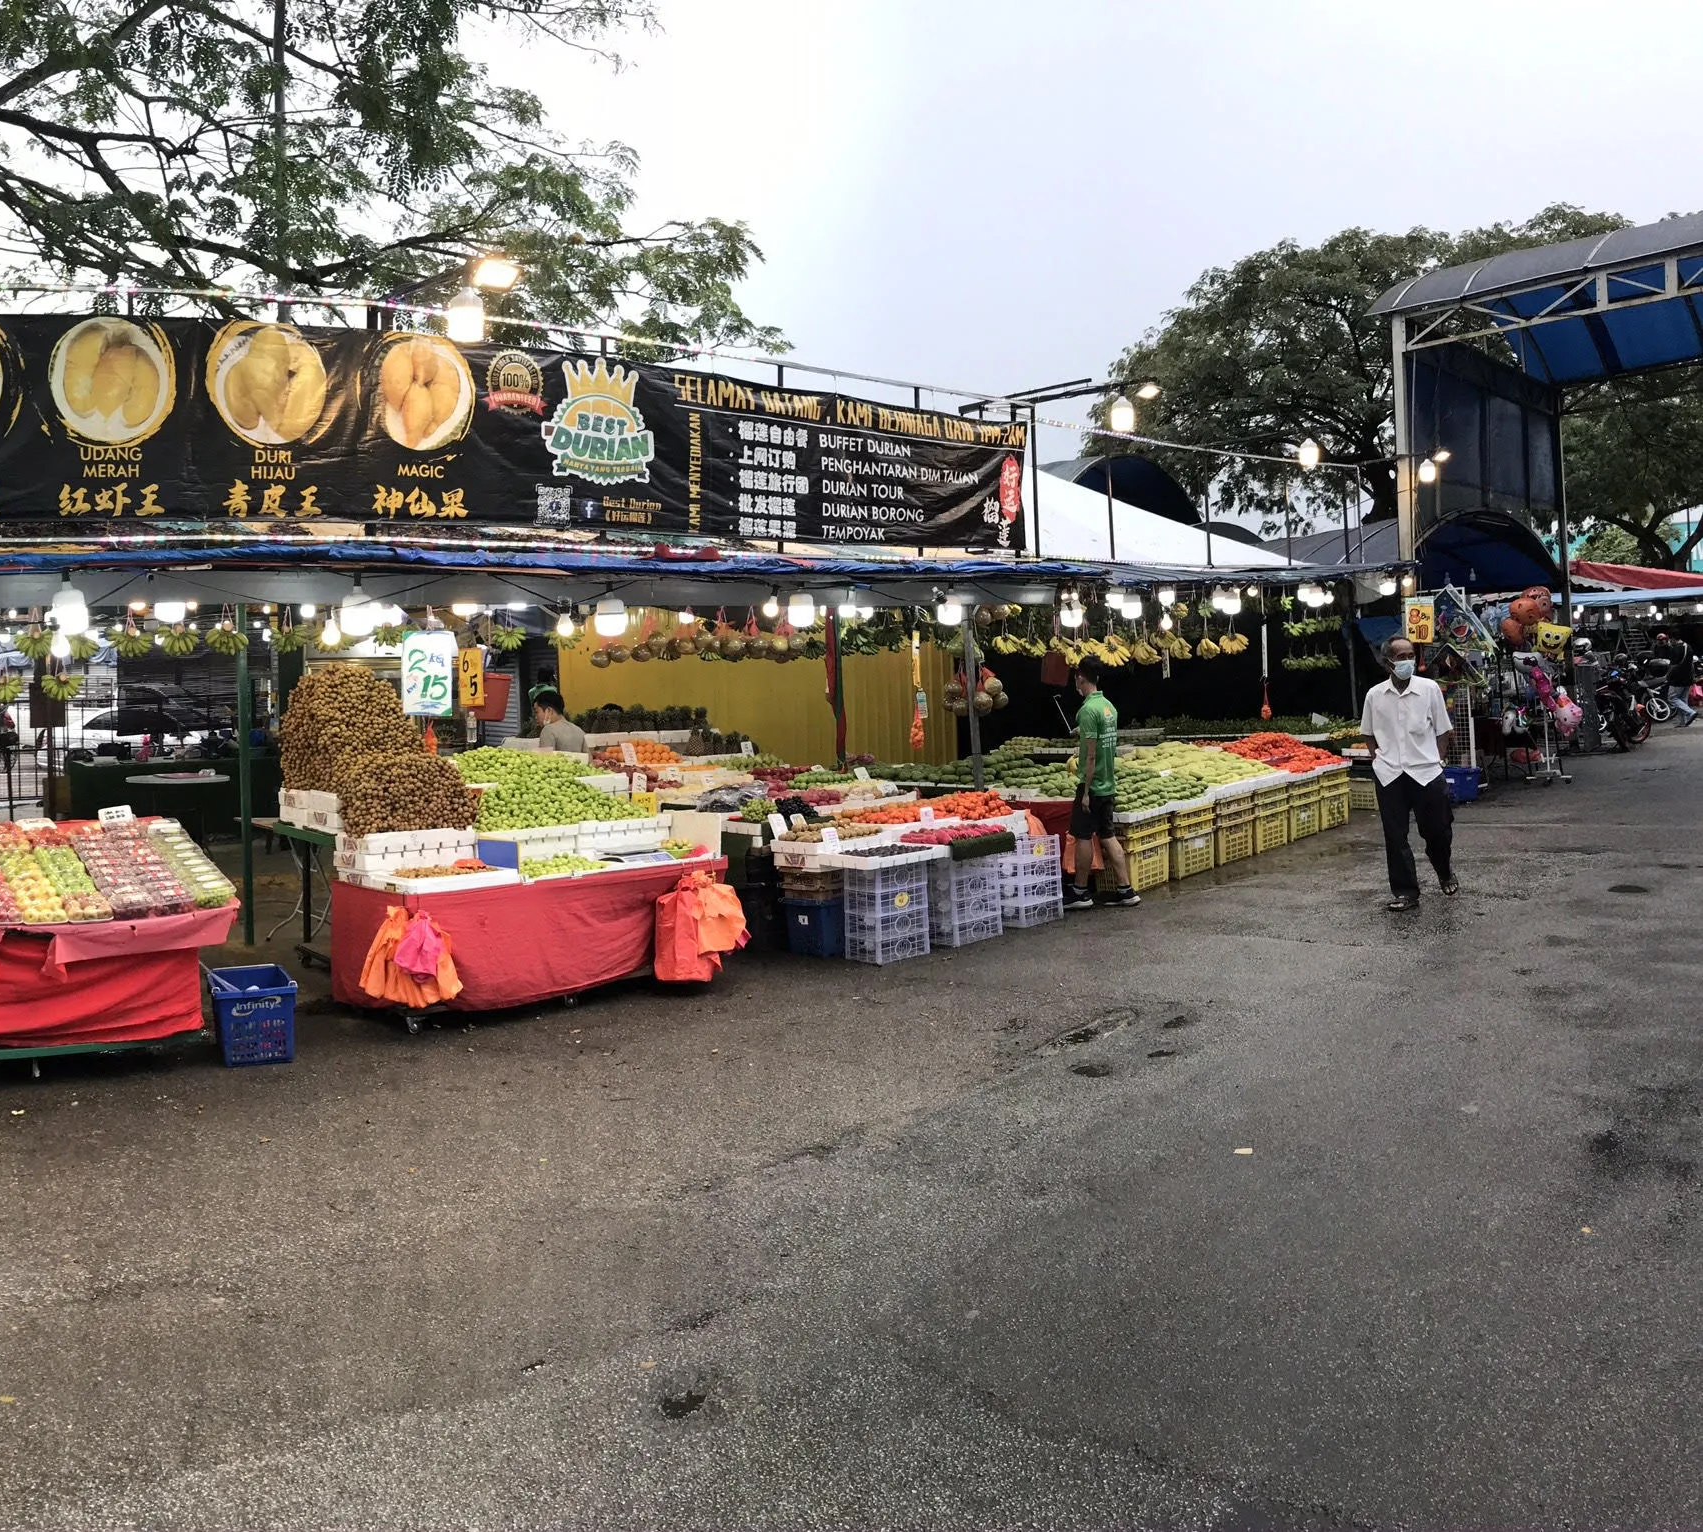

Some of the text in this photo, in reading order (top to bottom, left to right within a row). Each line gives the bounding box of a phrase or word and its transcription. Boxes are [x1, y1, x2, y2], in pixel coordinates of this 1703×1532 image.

[502, 372, 530, 389] 100%
[674, 373, 756, 411] SELAMAT
[836, 399, 873, 428] KAMI
[576, 411, 628, 437] BEST
[550, 424, 651, 462] DURIAN
[819, 434, 911, 457] BUFFET DURIAN
[80, 447, 143, 462] UDANG
[254, 449, 292, 465] DURI
[82, 464, 140, 478] MERAH
[250, 465, 296, 481] HIJAU
[397, 463, 445, 479] MAGIC
[688, 412, 702, 534] KAMI MENYEDIAKAN
[821, 456, 917, 480] PENGHANTARAN
[58, 482, 165, 517] 红虾王
[372, 483, 469, 519] 神仙果
[822, 480, 905, 501] DURIAN TOUR
[602, 495, 625, 508] Best
[822, 502, 925, 523] DURIAN BORONG
[821, 525, 886, 541] TEMPOYAK
[1409, 608, 1421, 625] 8
[1416, 624, 1429, 641] 10
[408, 649, 427, 673] 2
[420, 674, 448, 701] 15
[469, 674, 478, 697] 5
